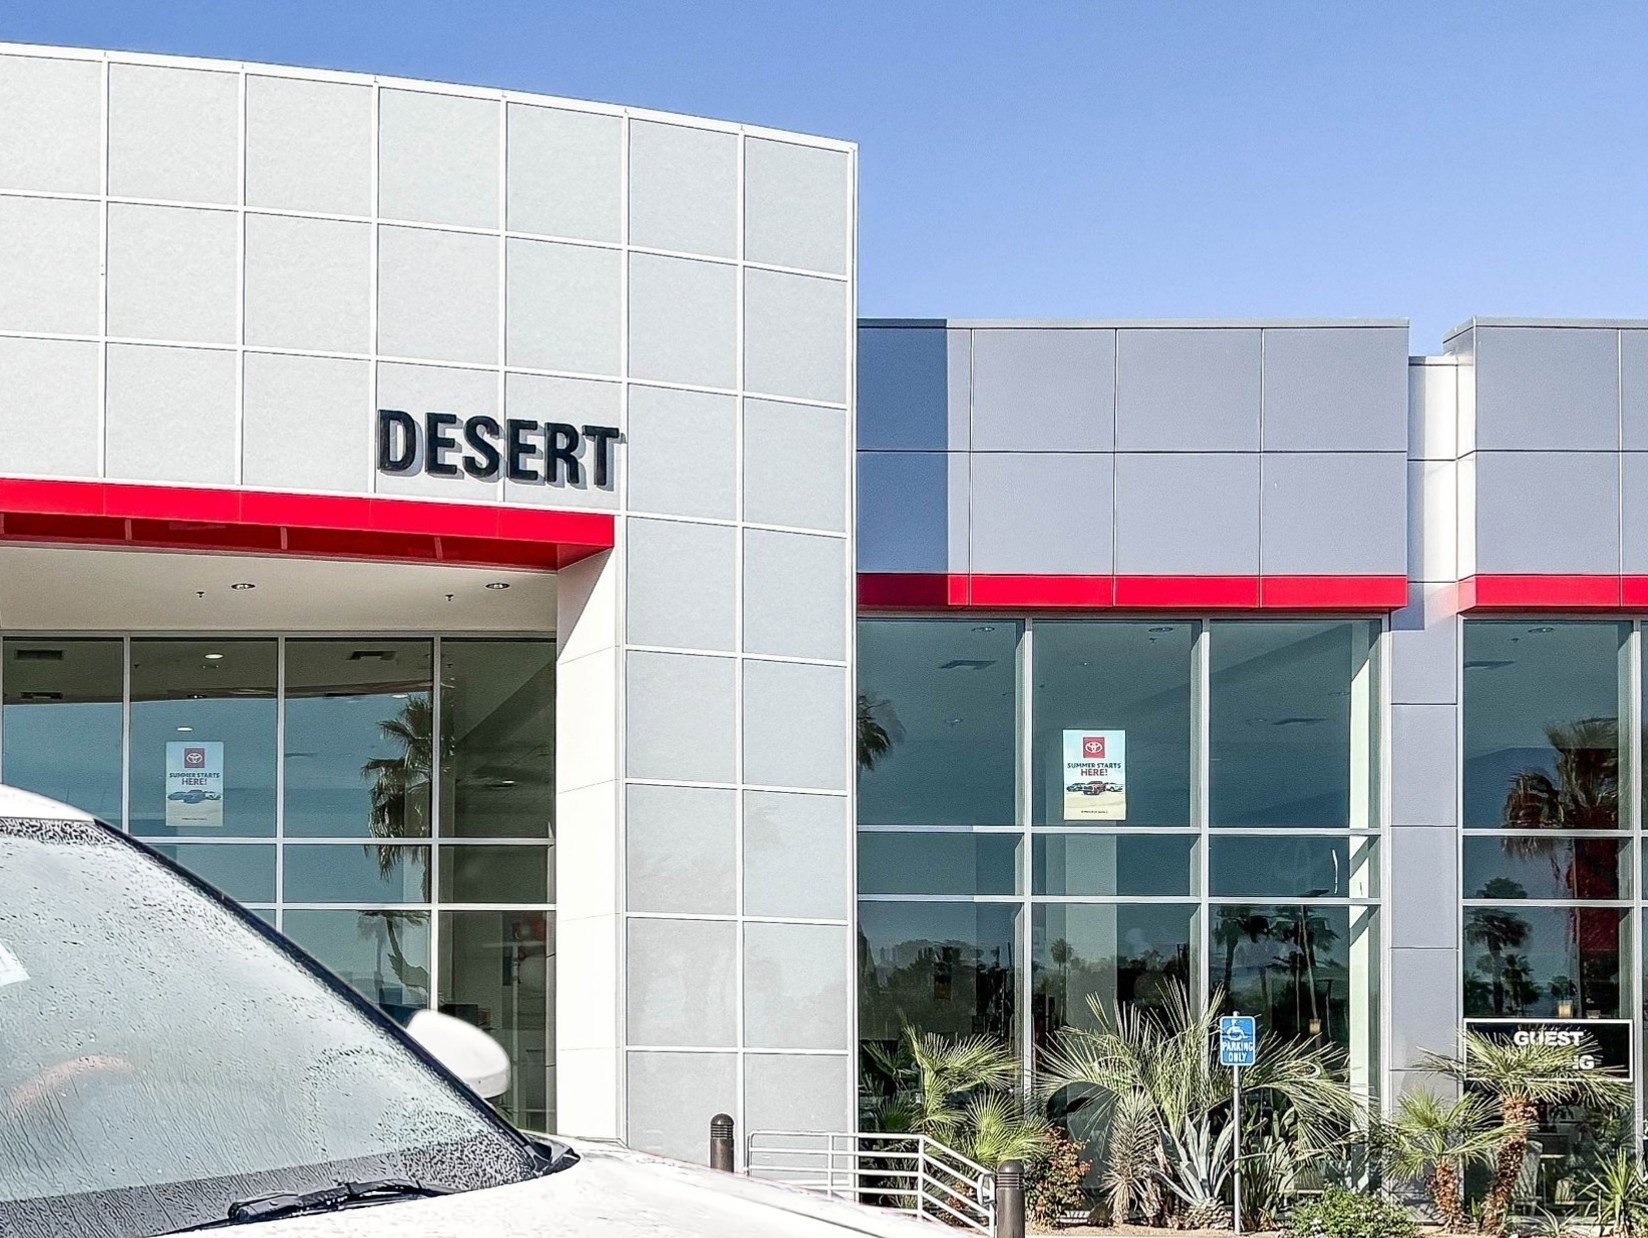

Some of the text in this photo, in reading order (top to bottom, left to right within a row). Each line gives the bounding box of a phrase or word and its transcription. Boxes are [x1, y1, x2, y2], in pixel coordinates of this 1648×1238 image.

[377, 409, 620, 487] DESERT
[1080, 768, 1108, 776] HERE!
[181, 778, 207, 786] HERE!
[1513, 1030, 1585, 1047] GUEST
[1222, 1041, 1254, 1052] PARKING
[1228, 1052, 1247, 1062] ONLY
